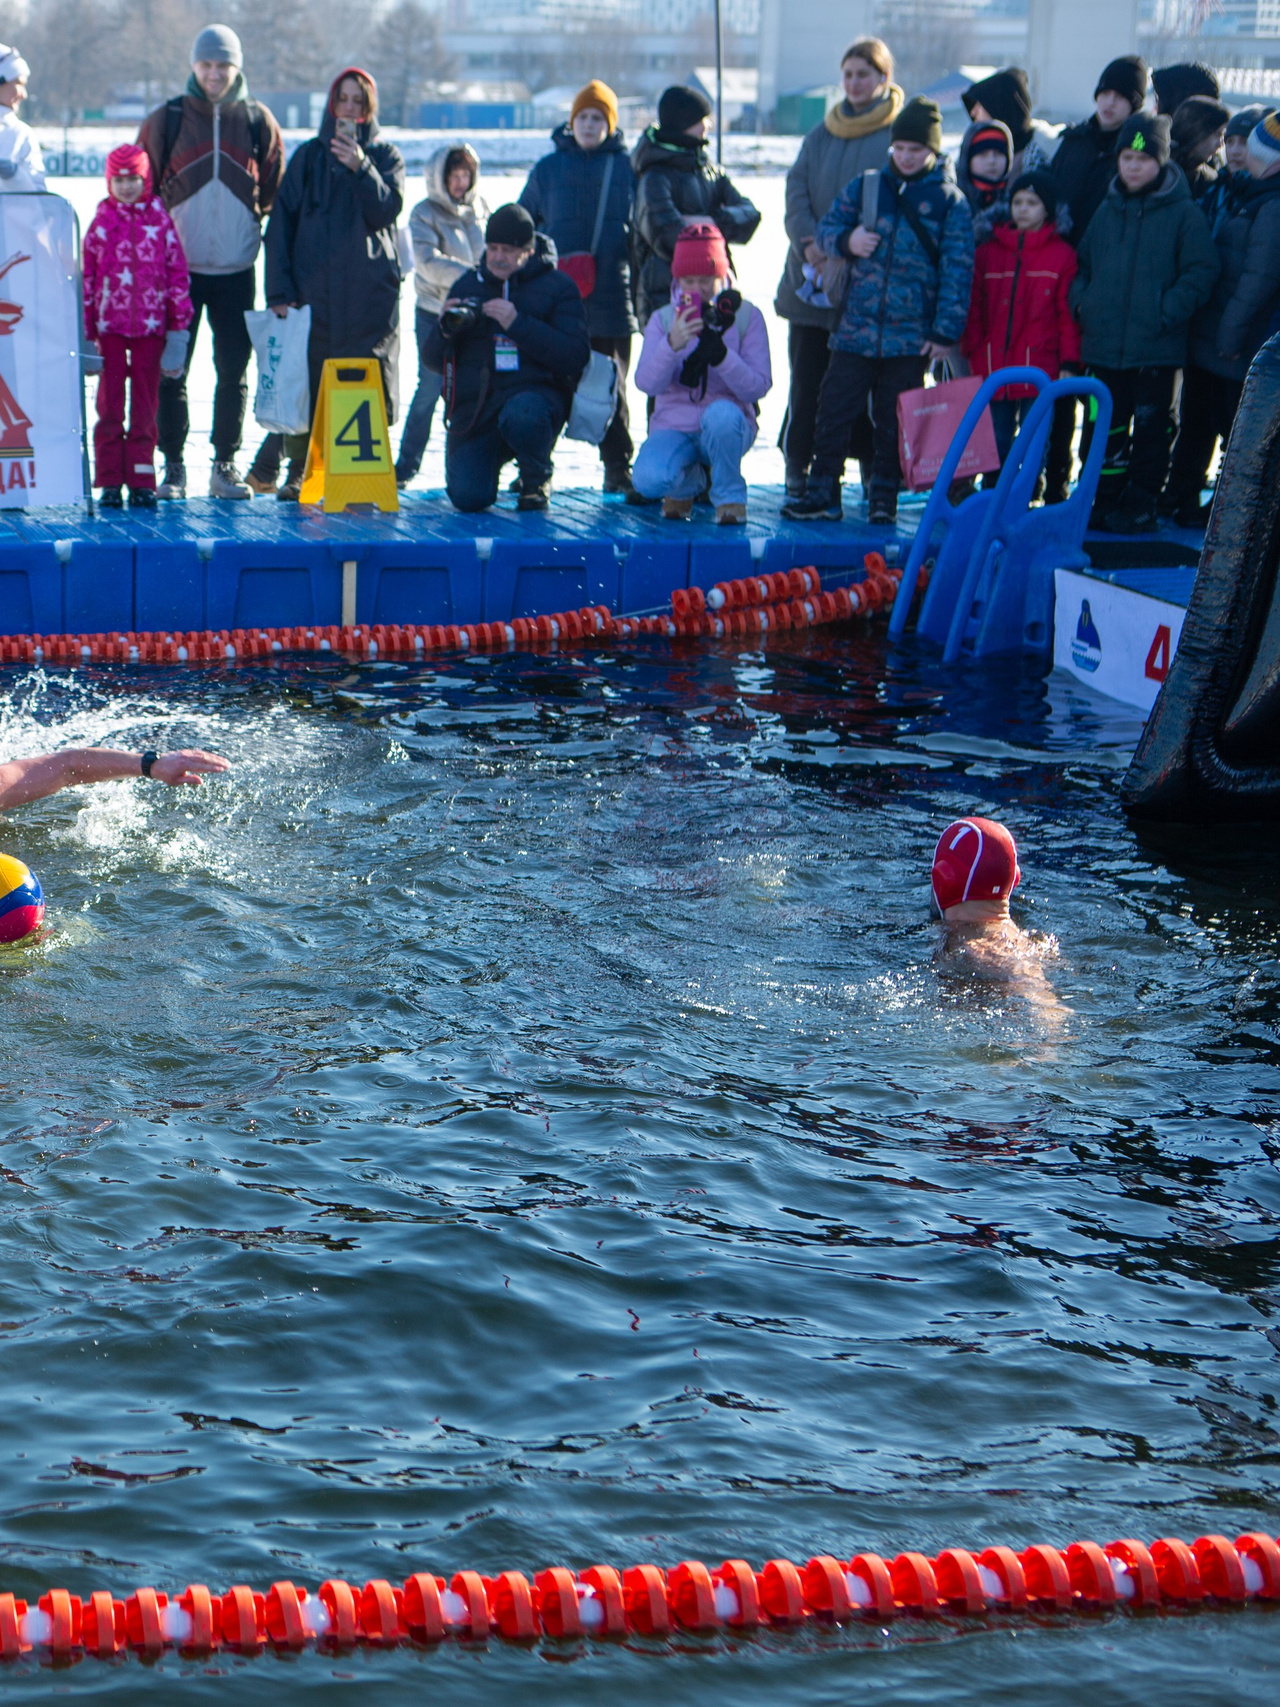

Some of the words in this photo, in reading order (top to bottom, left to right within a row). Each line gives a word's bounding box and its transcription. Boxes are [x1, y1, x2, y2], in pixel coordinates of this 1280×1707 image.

[335, 399, 382, 462] 4
[1144, 623, 1171, 684] 4
[949, 826, 972, 851] 1
